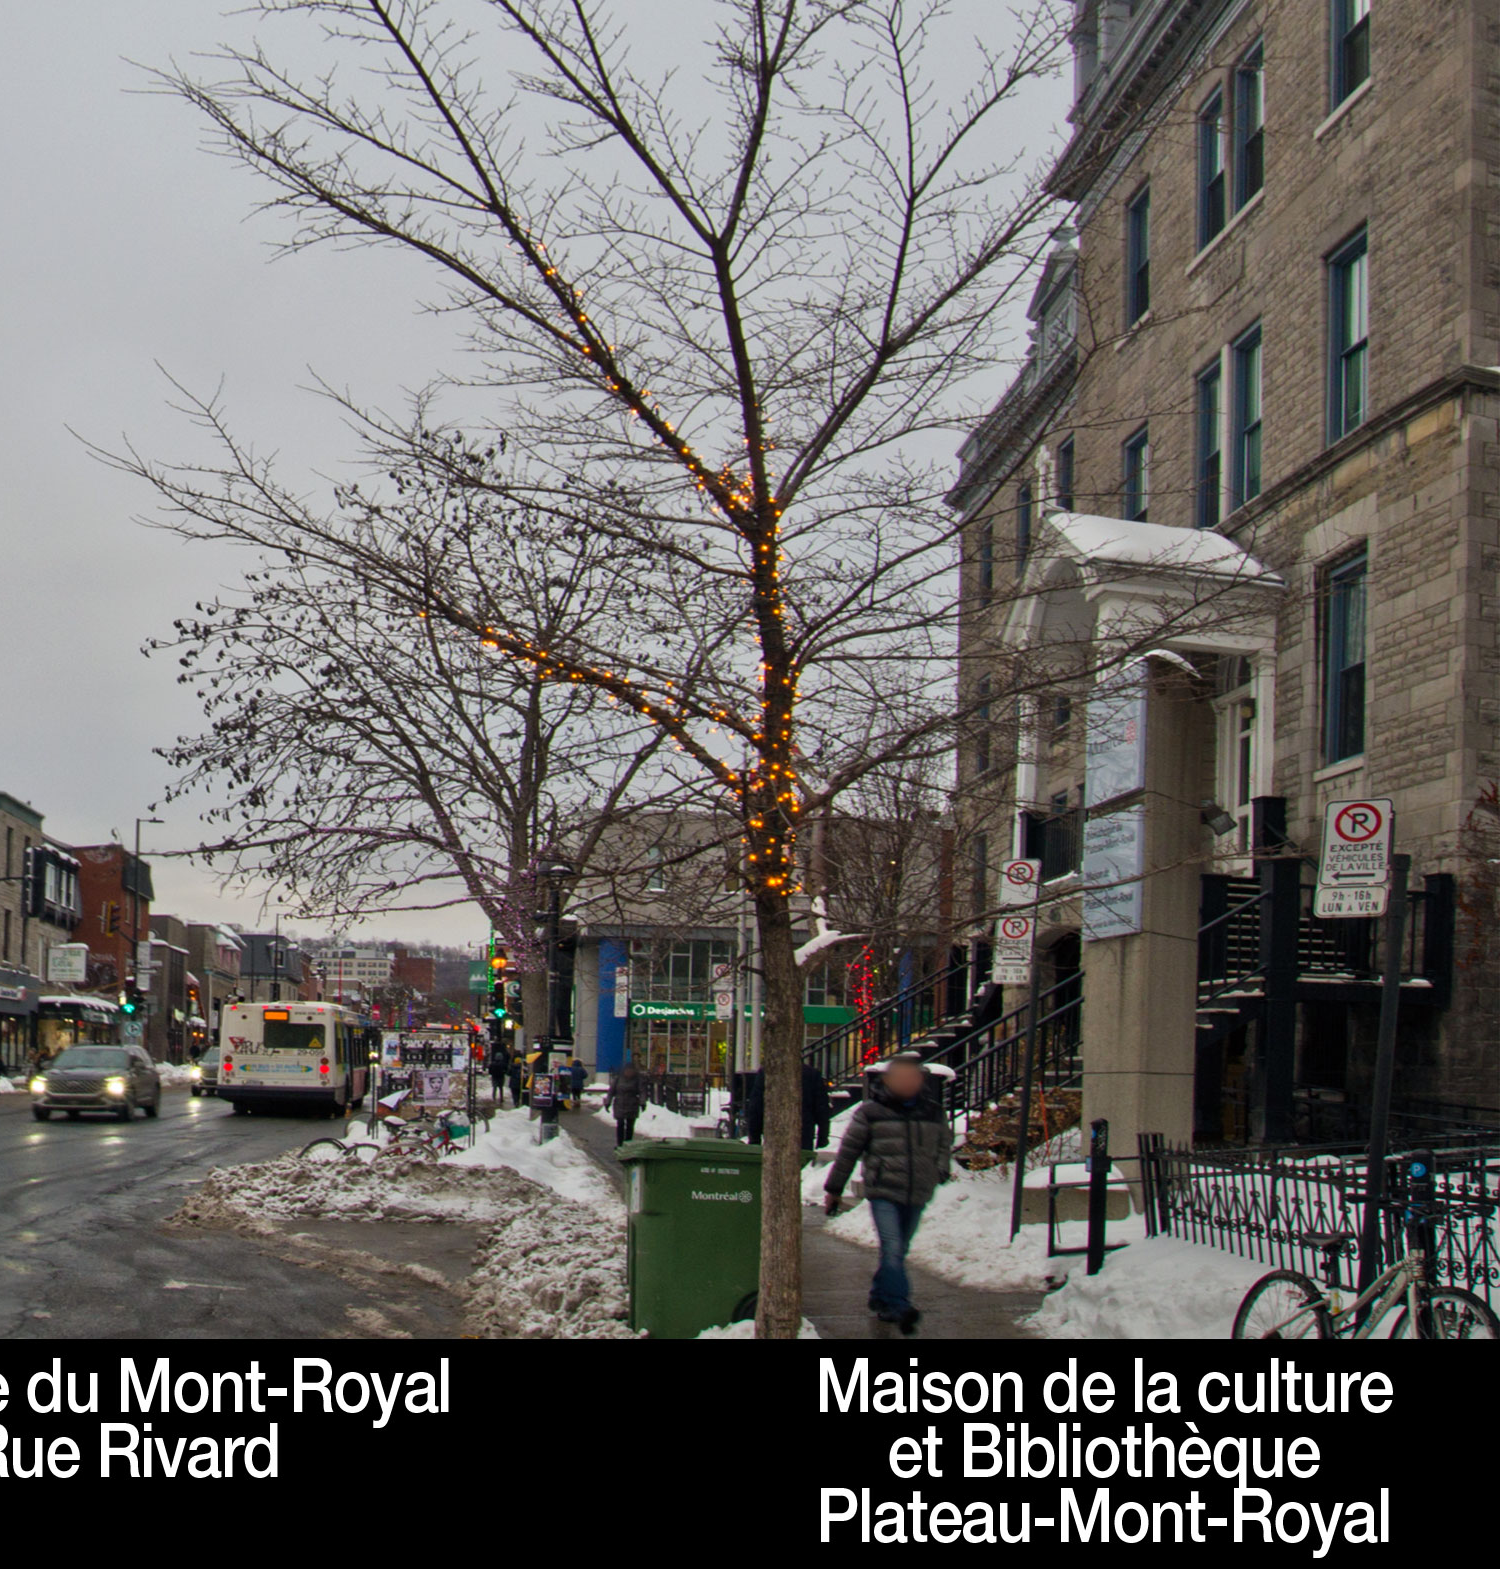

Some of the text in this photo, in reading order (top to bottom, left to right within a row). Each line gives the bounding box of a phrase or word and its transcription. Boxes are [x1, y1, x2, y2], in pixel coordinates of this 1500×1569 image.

[1329, 840, 1384, 853] EXCEPTÉ
[1328, 851, 1384, 863] VÉHICULES
[1325, 863, 1338, 872] DE
[1356, 861, 1386, 871] VILLE
[1331, 891, 1345, 902] 9h
[1354, 890, 1372, 901] 16h
[1322, 902, 1343, 913] LUN
[1358, 901, 1380, 912] VEN
[691, 1190, 738, 1201] Montréal
